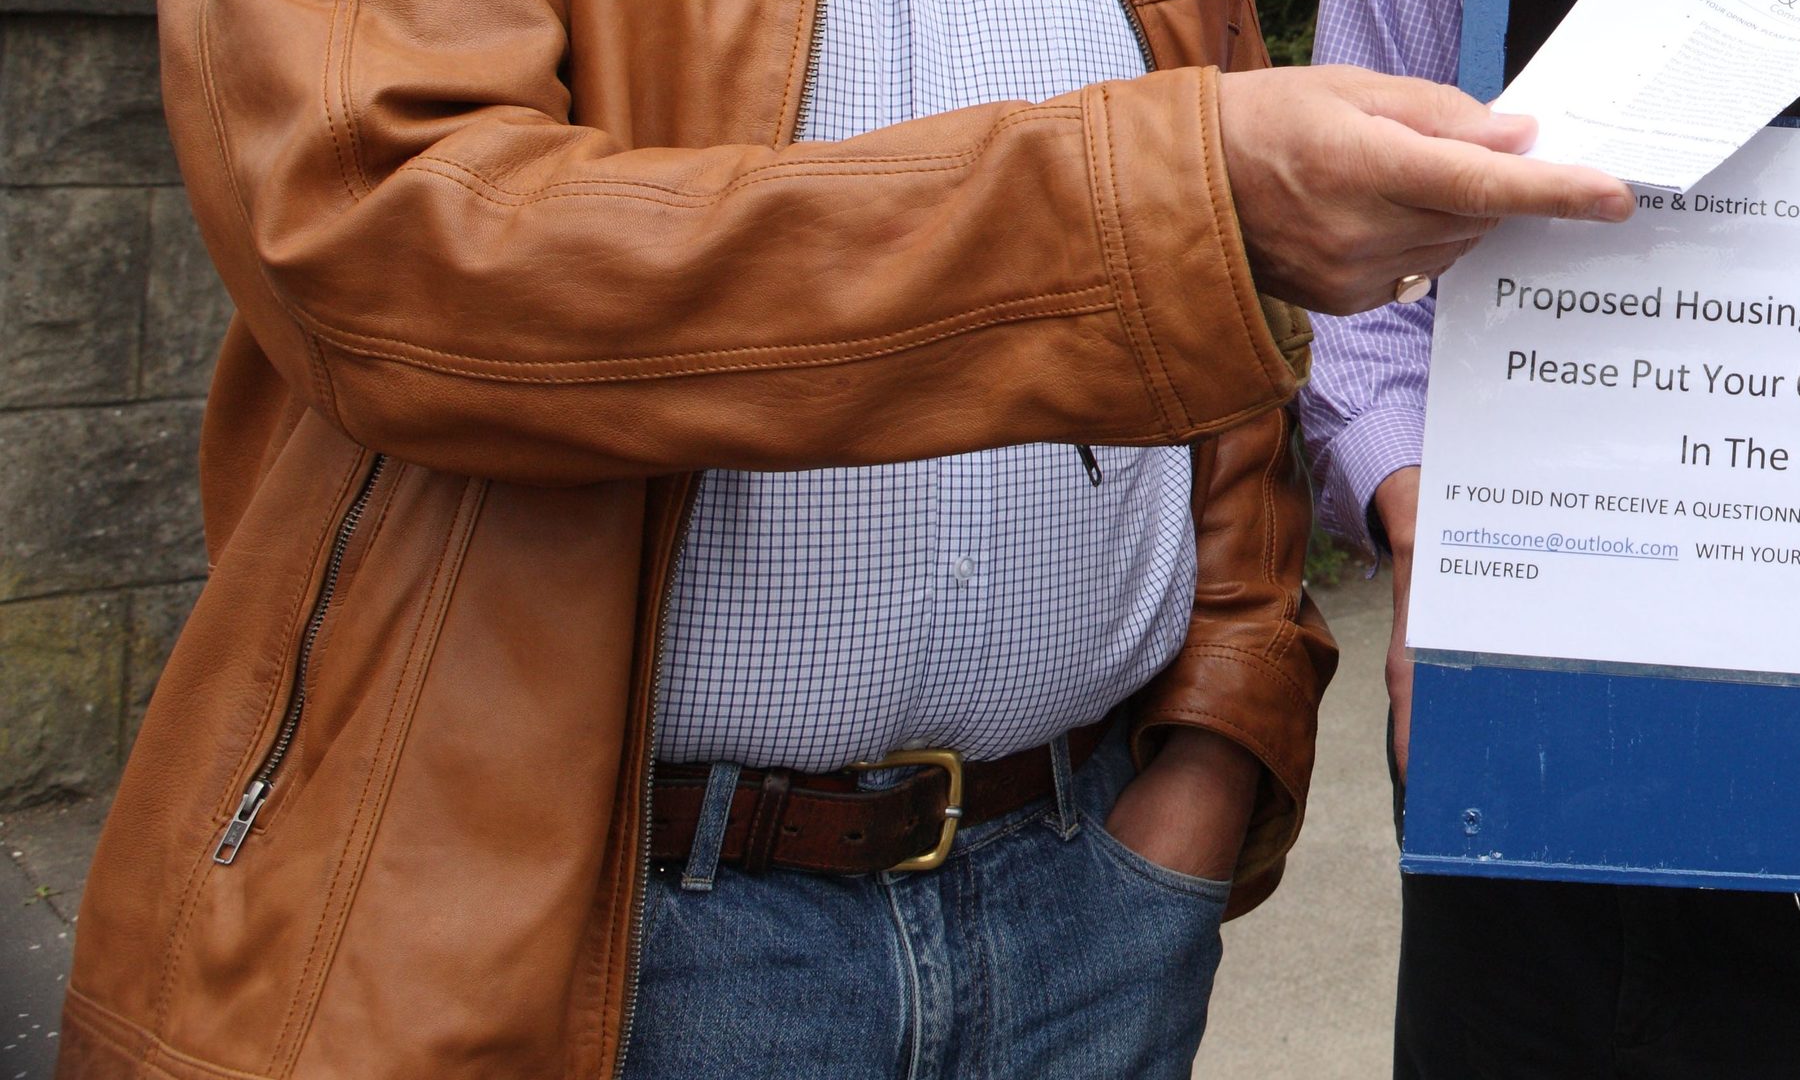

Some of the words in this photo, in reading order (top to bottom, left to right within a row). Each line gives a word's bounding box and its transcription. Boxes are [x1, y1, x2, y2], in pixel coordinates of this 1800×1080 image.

[1705, 0, 1726, 16] YOUR
[1670, 193, 1687, 211] &
[1694, 194, 1767, 216] District
[1496, 278, 1662, 319] Proposed
[1506, 350, 1619, 387] Please
[1632, 359, 1690, 392] Put
[1703, 363, 1785, 397] Your
[1681, 435, 1710, 466] In
[1724, 437, 1789, 470] The
[1446, 484, 1461, 500] IF
[1466, 485, 1505, 504] YOU
[1511, 489, 1544, 506] DID
[1550, 491, 1589, 509] NOT
[1595, 495, 1669, 515] RECEIVE
[1674, 499, 1687, 516] A
[1441, 526, 1679, 560] northscone@outlook.com
[1695, 543, 1744, 562] WITH
[1750, 546, 1800, 565] YOUR
[1439, 557, 1539, 580] DELIVERED
